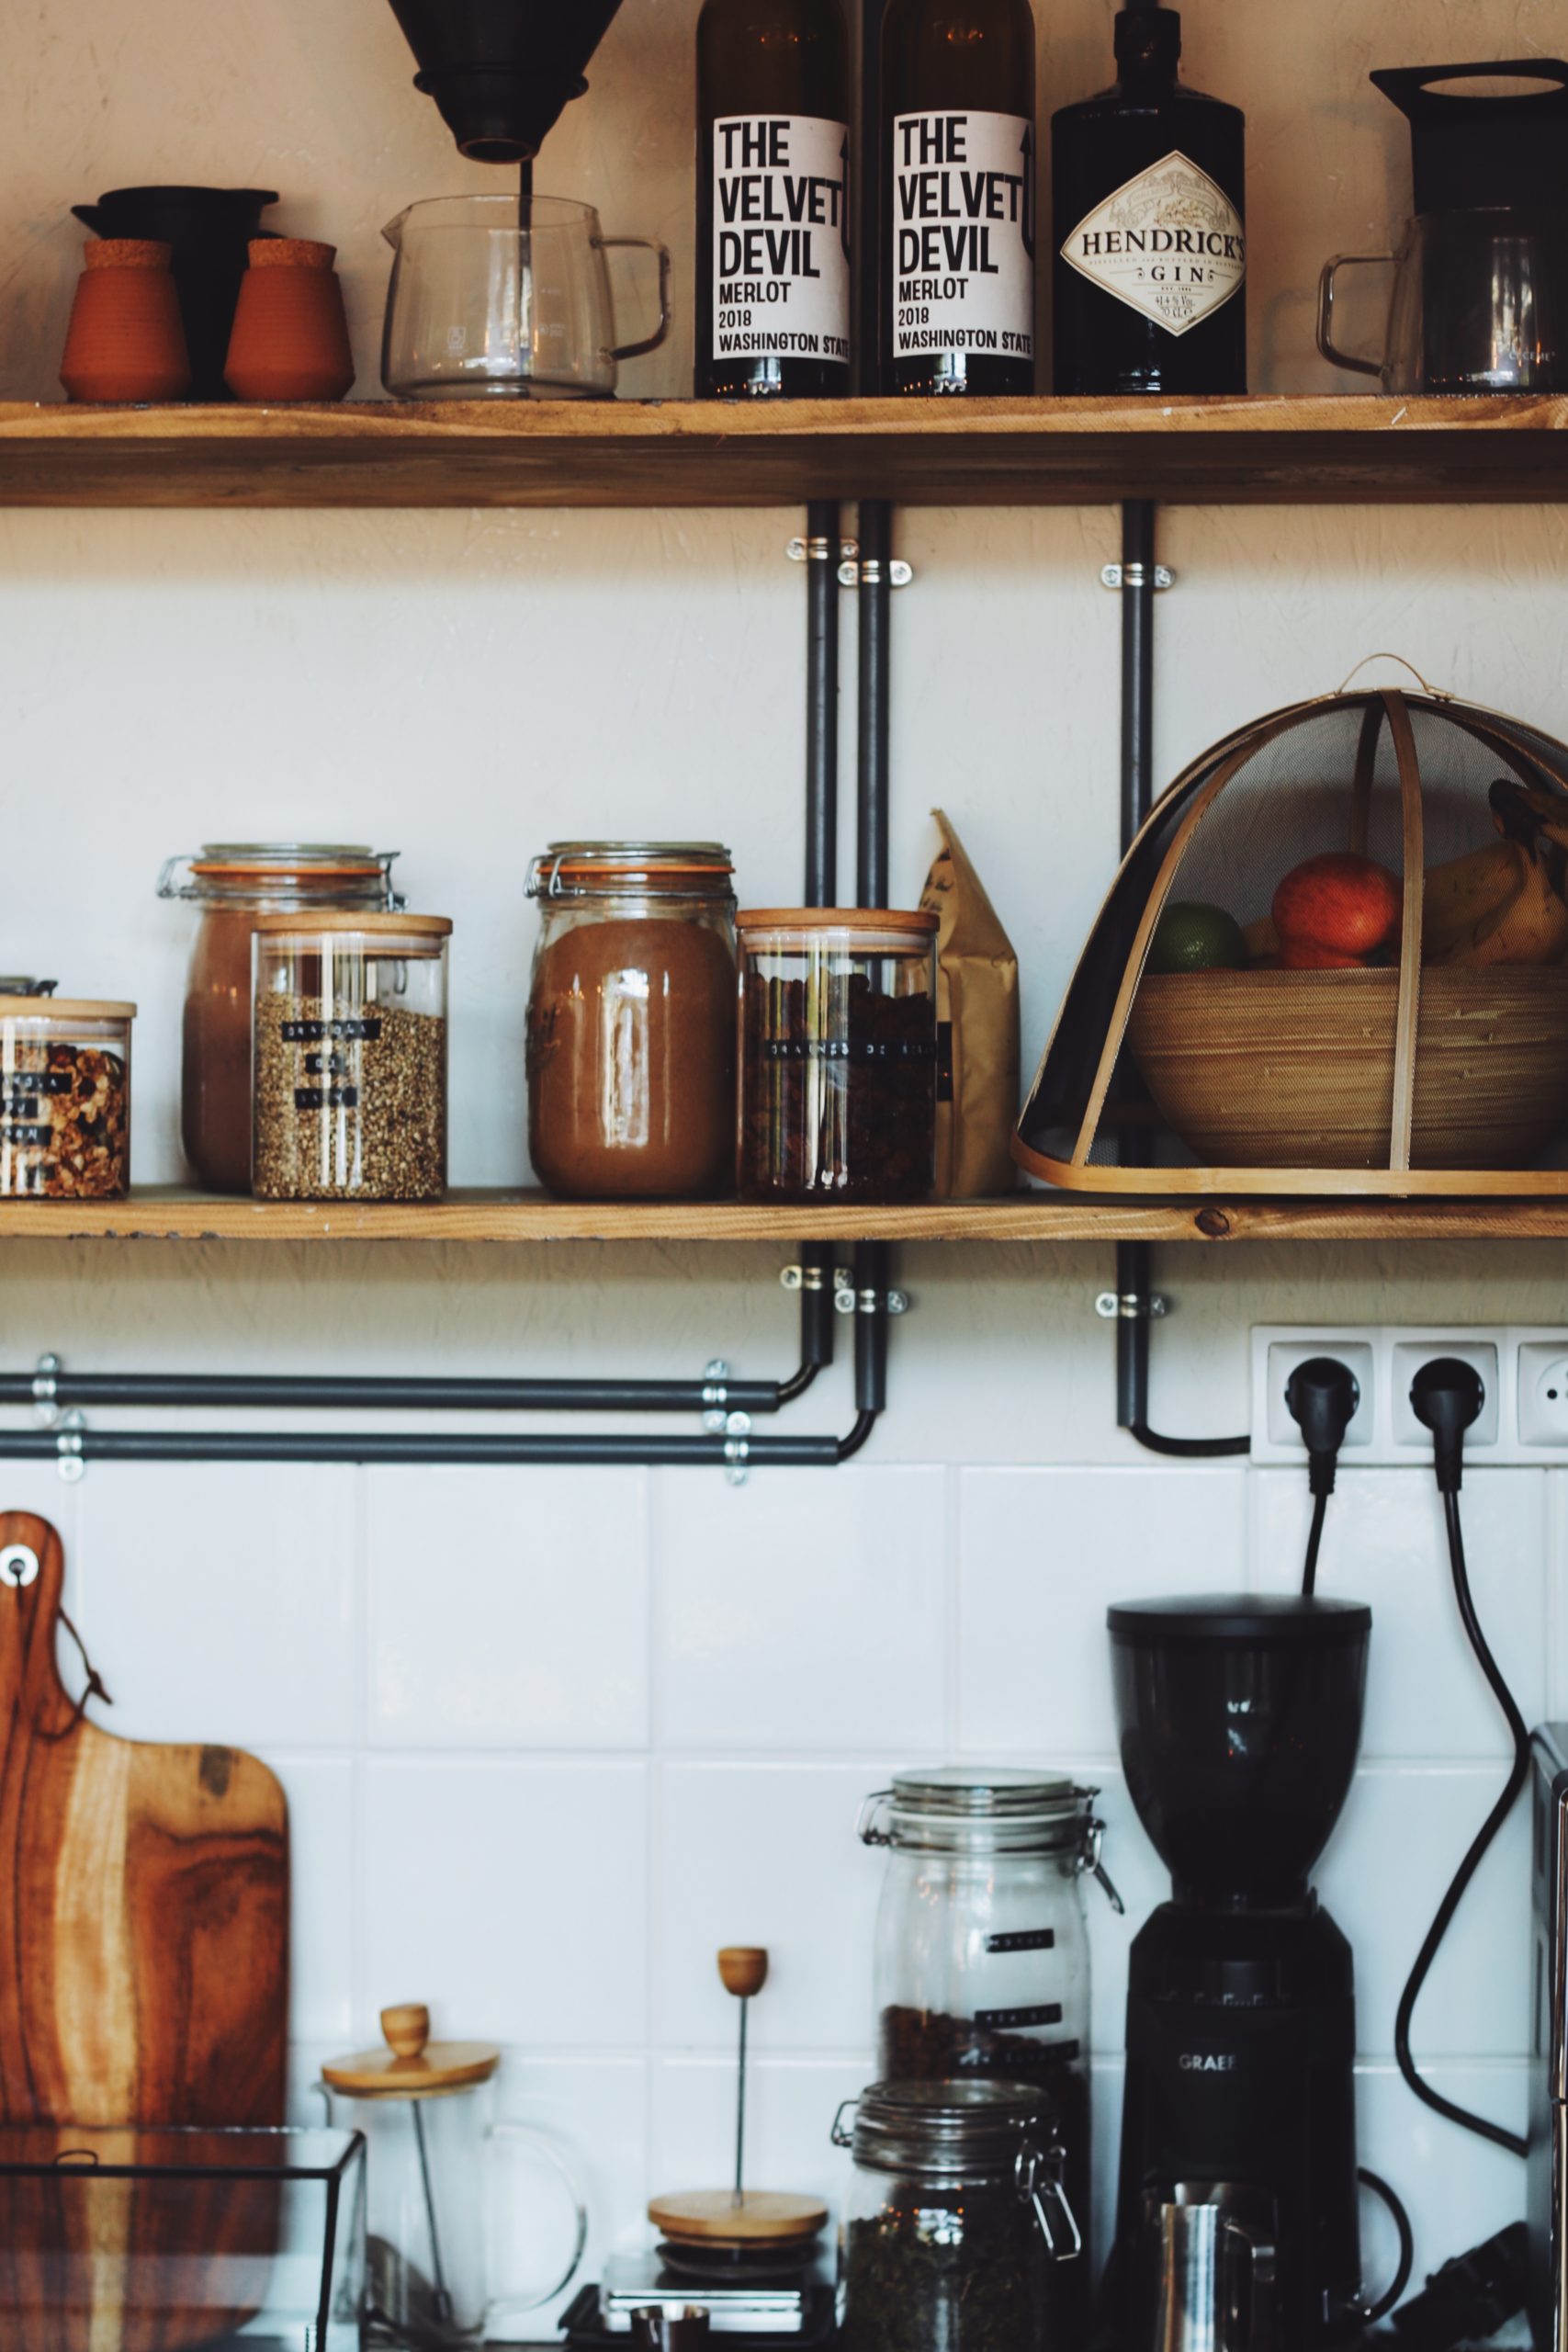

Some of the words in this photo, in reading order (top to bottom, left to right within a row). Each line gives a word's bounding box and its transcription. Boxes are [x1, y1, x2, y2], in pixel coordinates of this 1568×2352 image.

[718, 120, 790, 169] THE
[898, 117, 967, 167] THE
[718, 175, 842, 227] VELVET
[898, 172, 1022, 222] VELVET
[718, 229, 820, 278] DEVIL
[898, 225, 998, 276] DEVIL
[1082, 229, 1245, 263] HENDRICK'S
[1151, 266, 1204, 283] GIN
[718, 281, 791, 304] MERLOT
[898, 278, 968, 302] MERLOT
[718, 310, 751, 328] 2018
[898, 307, 930, 326] 2018
[718, 333, 818, 353] WASHINGTON
[823, 335, 849, 358] STATE
[898, 329, 997, 351] WASHINGTON
[1002, 331, 1031, 355] STATE
